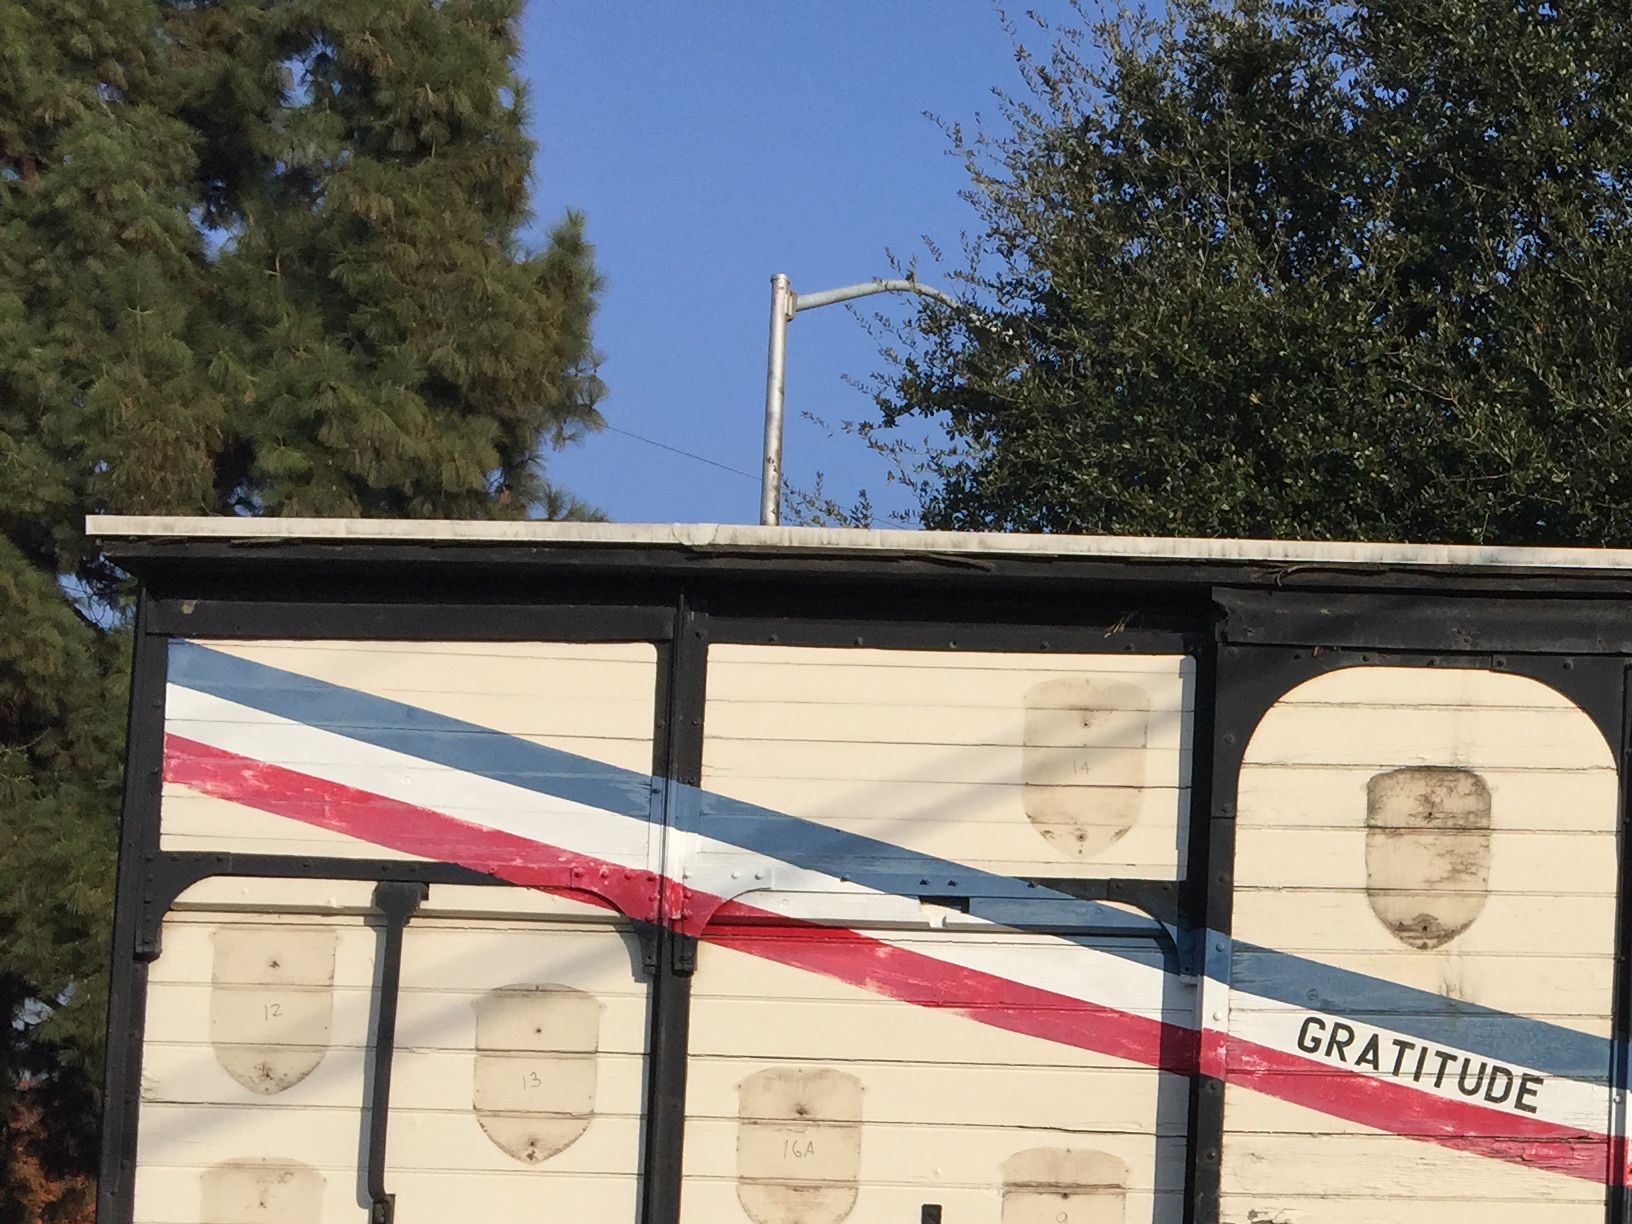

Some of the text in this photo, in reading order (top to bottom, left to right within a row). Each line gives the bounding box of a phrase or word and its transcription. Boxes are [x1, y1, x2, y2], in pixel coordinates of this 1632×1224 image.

[1073, 760, 1092, 775] 14
[264, 1003, 283, 1021] 12
[1298, 1015, 1545, 1114] GRATITUDE
[522, 1071, 542, 1090] 13
[784, 1139, 815, 1159] 16A
